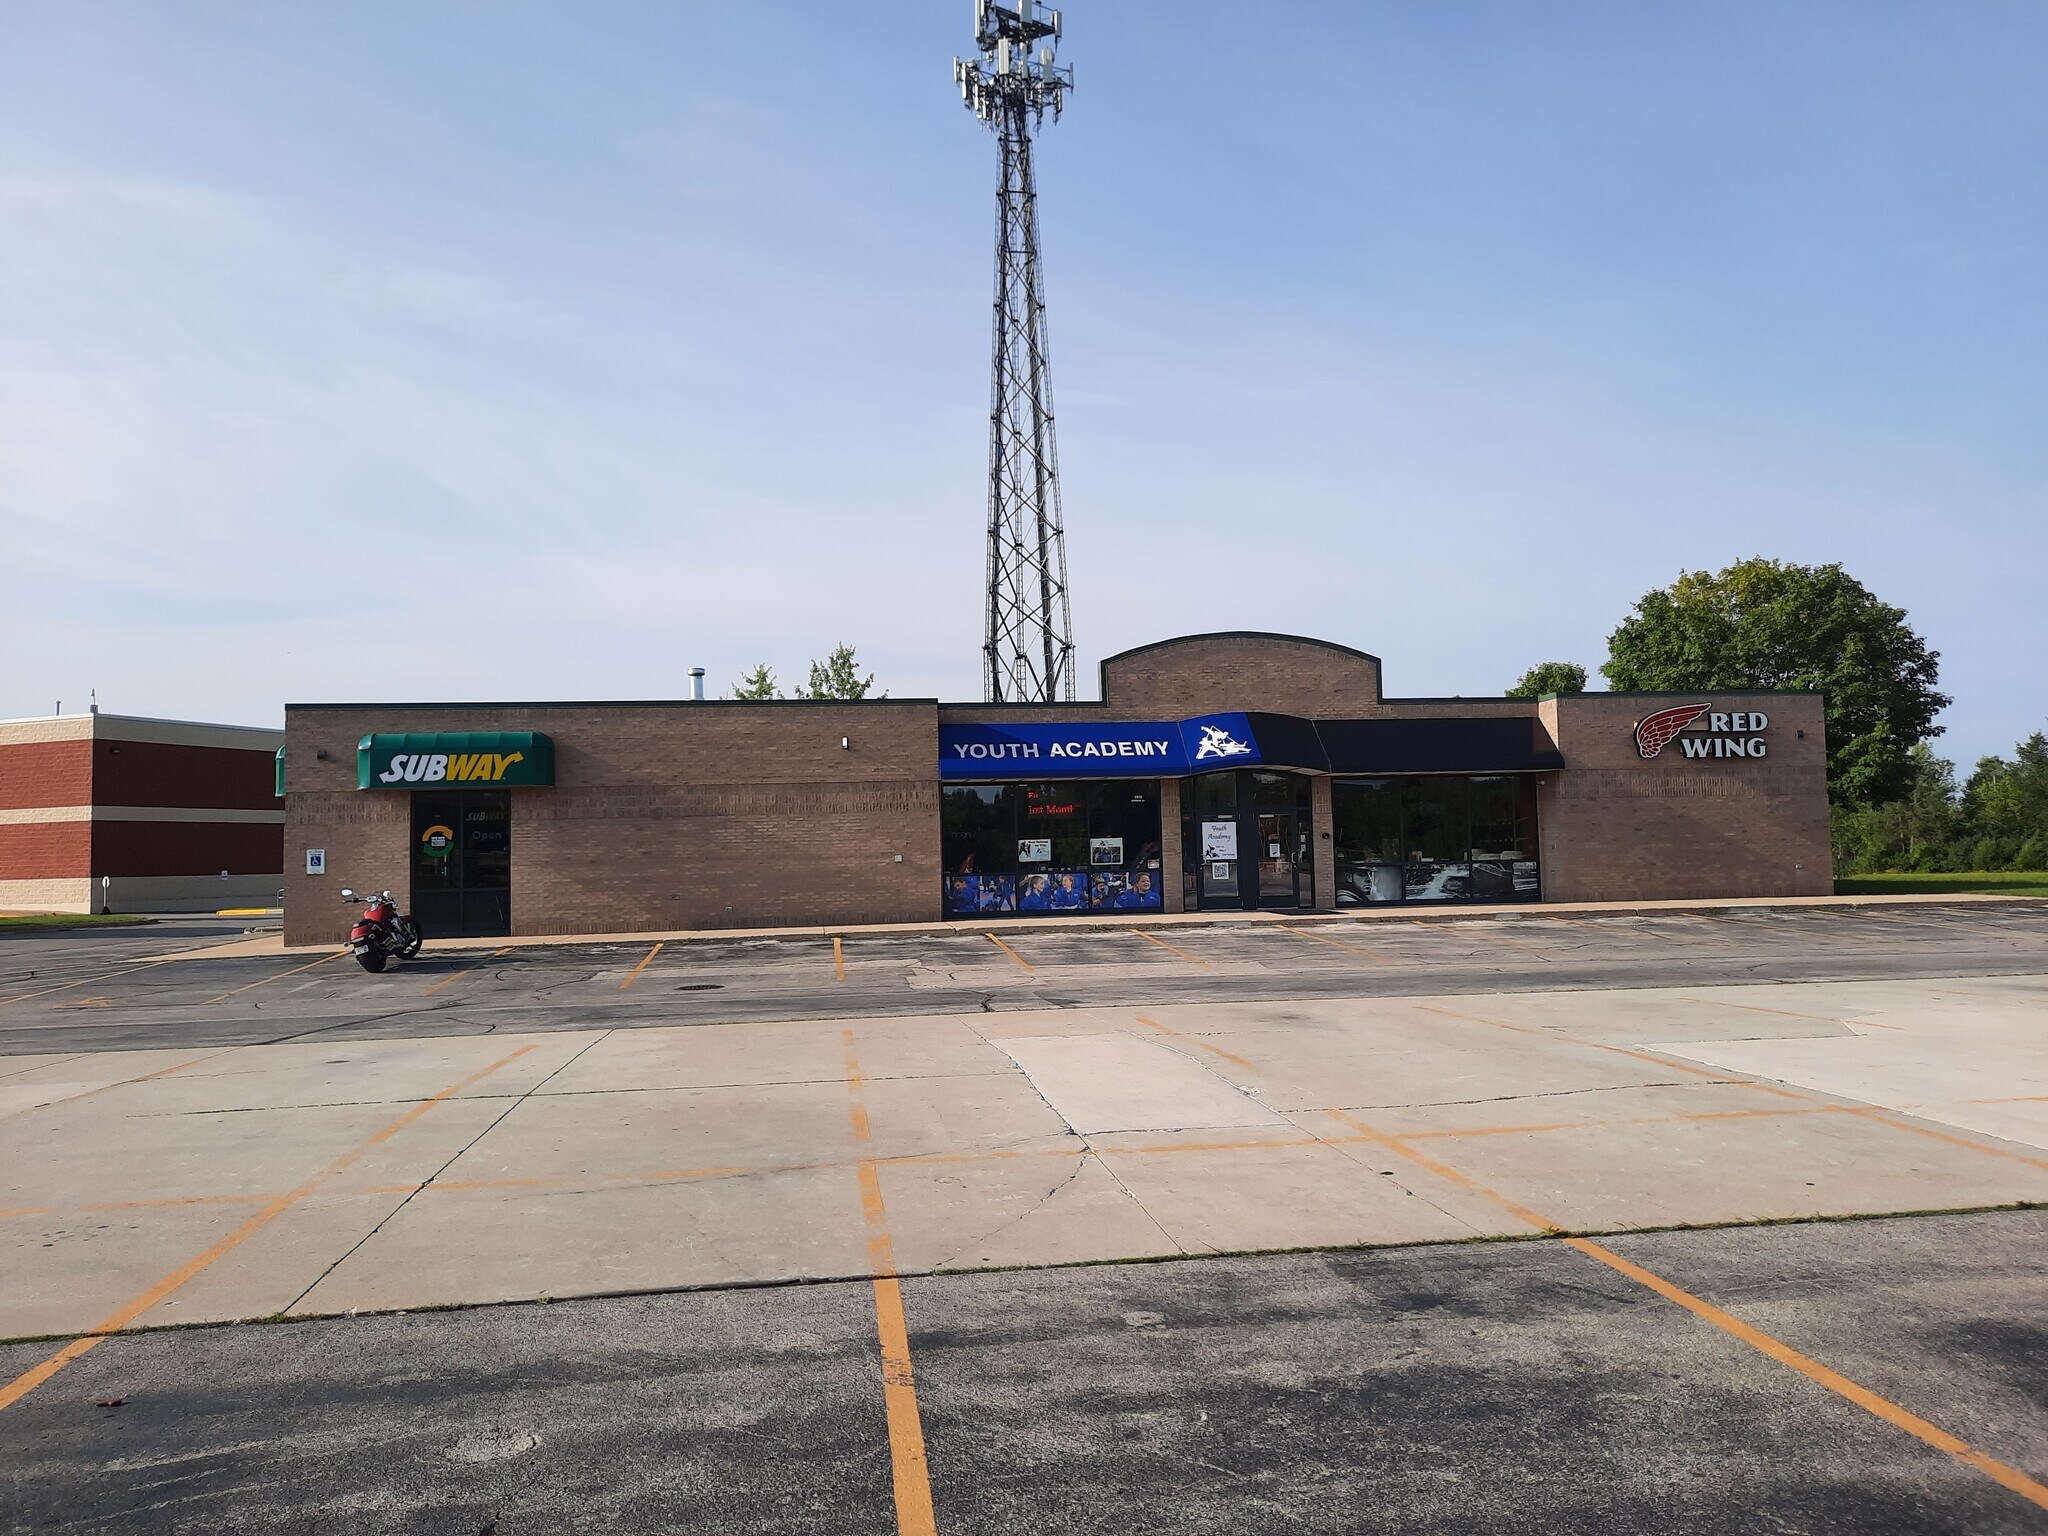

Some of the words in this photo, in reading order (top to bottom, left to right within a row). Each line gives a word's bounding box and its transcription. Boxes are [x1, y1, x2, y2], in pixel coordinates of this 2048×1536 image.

[1709, 712, 1769, 733] RED
[953, 743, 1040, 759] YOUTH
[1049, 741, 1169, 758] ACADEMY
[1680, 737, 1767, 758] WING
[378, 751, 524, 784] SUBWAY
[465, 811, 507, 822] SUBWAY
[472, 830, 502, 842] Open
